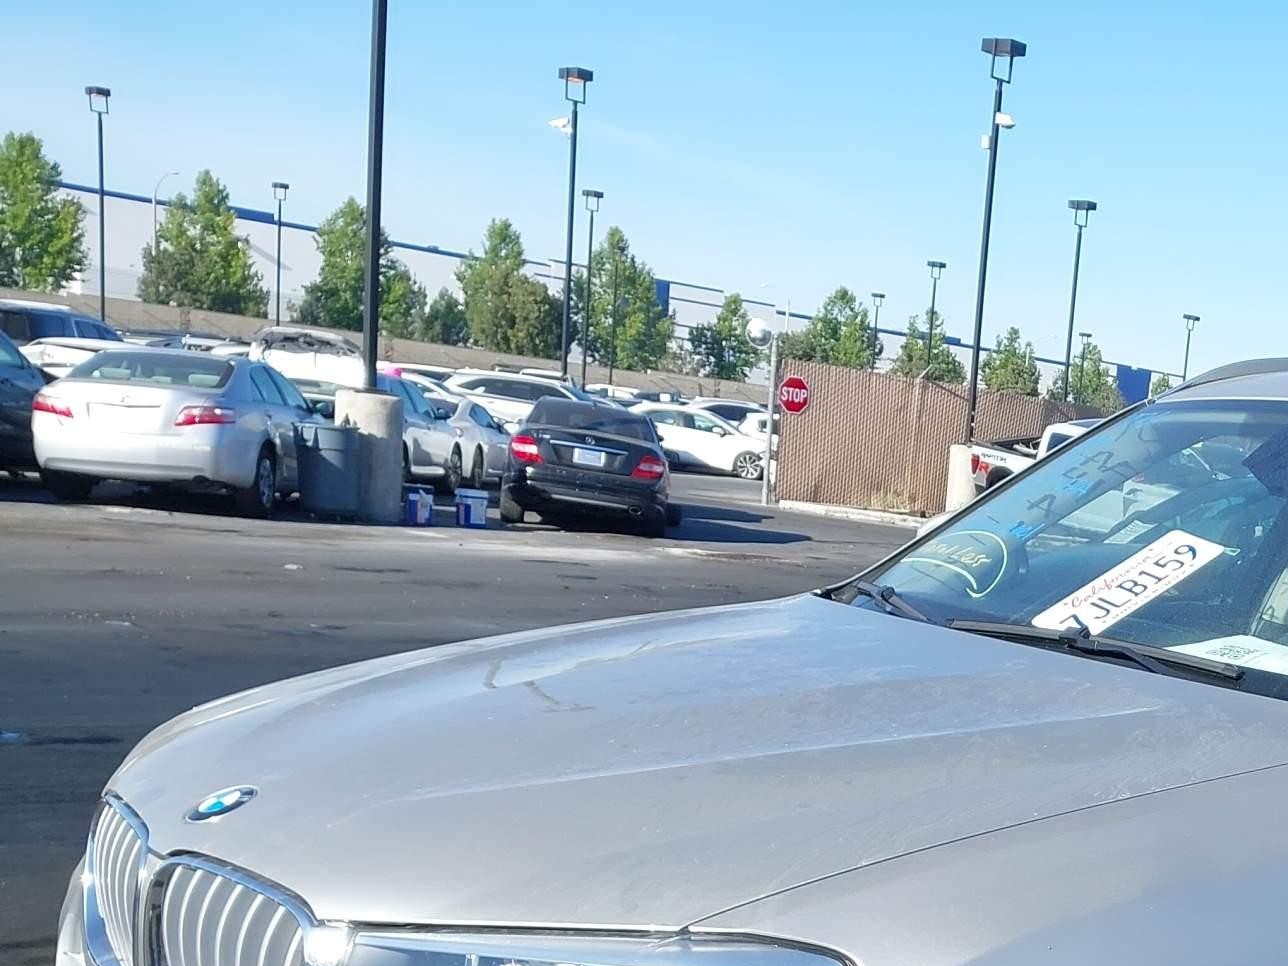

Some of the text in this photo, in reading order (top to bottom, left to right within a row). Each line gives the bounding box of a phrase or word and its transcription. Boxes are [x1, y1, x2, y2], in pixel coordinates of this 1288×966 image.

[781, 386, 807, 403] STOP
[1059, 544, 1197, 629] 7JLB159
[1071, 553, 1155, 608] California
